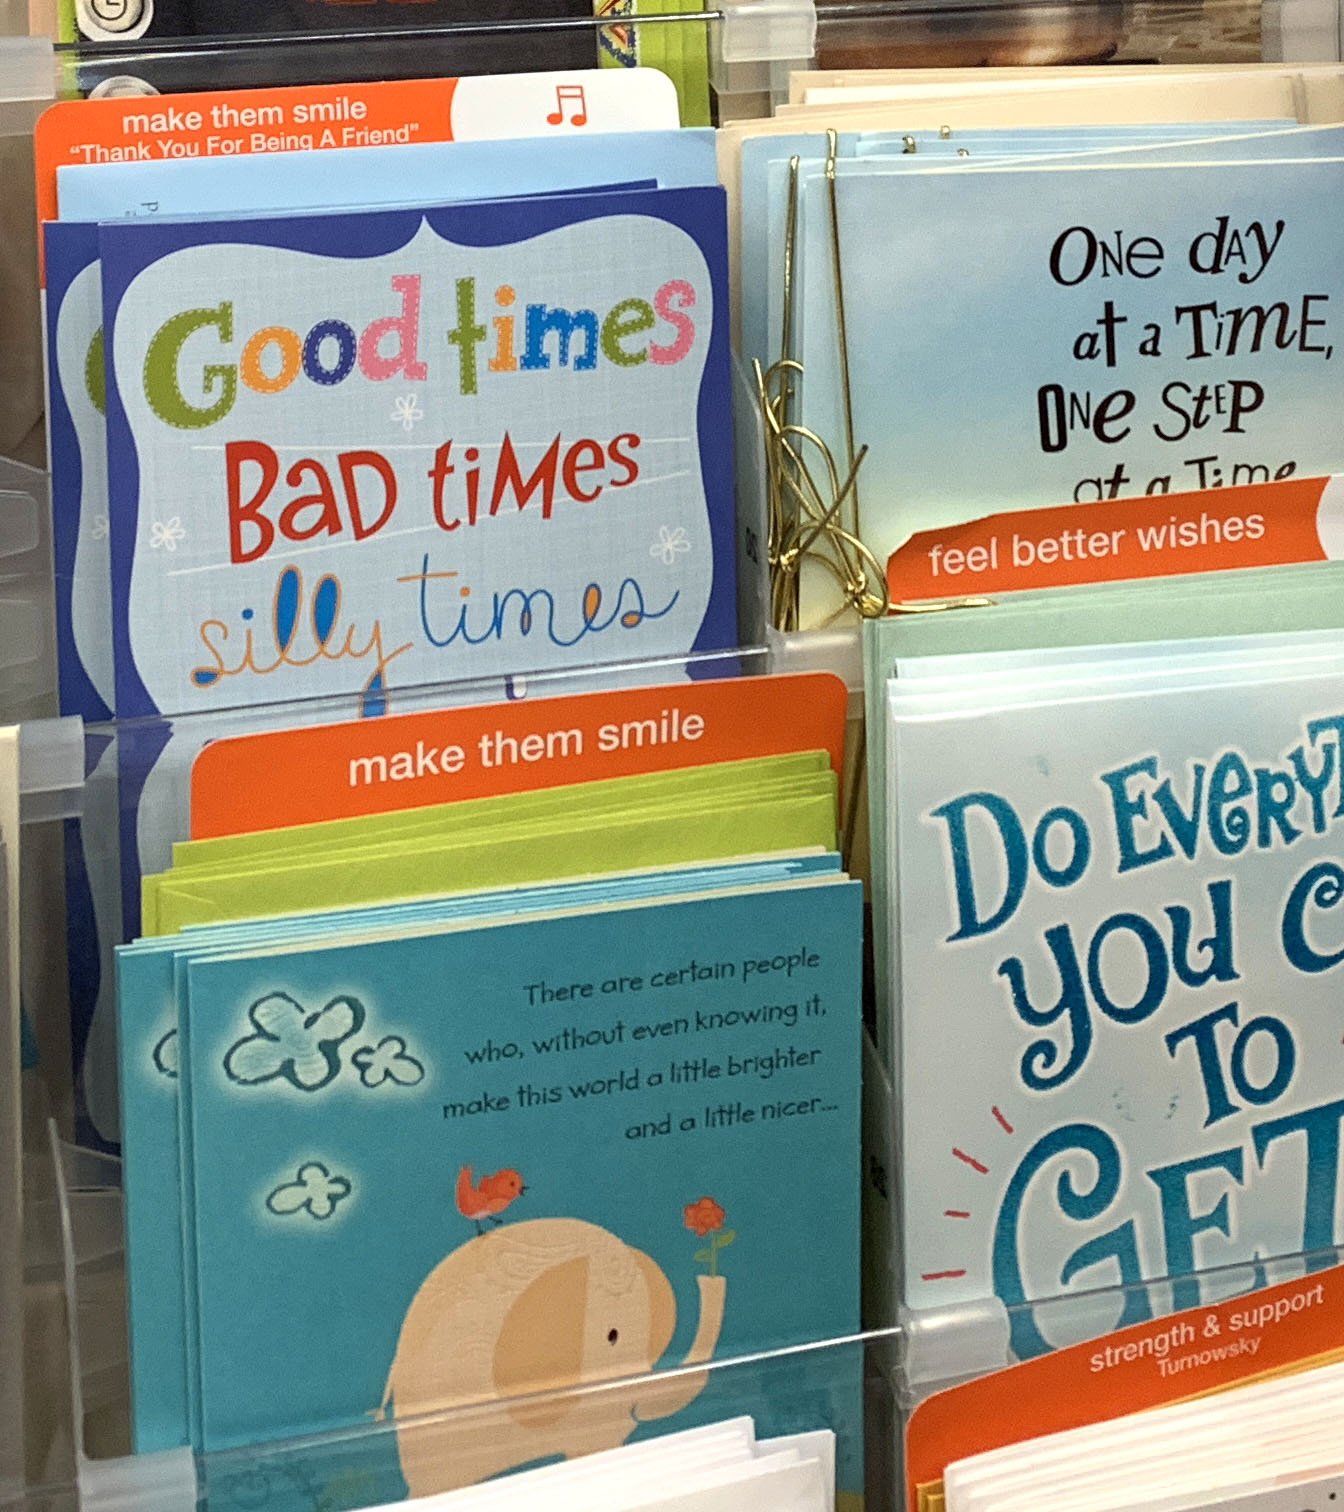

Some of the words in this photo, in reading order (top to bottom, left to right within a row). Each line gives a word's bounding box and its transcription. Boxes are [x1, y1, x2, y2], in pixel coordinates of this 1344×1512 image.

[123, 108, 202, 133] make
[211, 104, 283, 128] them
[293, 97, 366, 123] smile
[156, 137, 200, 159] You
[206, 136, 245, 156] For
[250, 131, 314, 156] Being
[320, 130, 335, 146] A
[143, 274, 427, 429] Good
[448, 277, 695, 395] times
[1073, 301, 1127, 367] at
[1139, 324, 1161, 356] a
[928, 533, 997, 576] feel
[1012, 525, 1124, 568] better
[1137, 513, 1264, 551] wishes
[192, 564, 415, 717] silly
[397, 554, 680, 647] times
[348, 745, 465, 787] make
[479, 730, 582, 767] them
[599, 709, 704, 750] smile
[524, 981, 593, 1005] There
[601, 977, 643, 993] are
[651, 960, 735, 987] certain
[743, 947, 820, 983] people
[464, 1040, 524, 1064] who,
[532, 1021, 624, 1053] without
[632, 1019, 689, 1040] even
[696, 1004, 798, 1040] knowing
[804, 999, 828, 1019] it,
[443, 1092, 510, 1118] make
[517, 1084, 562, 1107] this
[567, 1069, 640, 1102] world
[647, 1073, 662, 1087] a
[671, 1058, 720, 1083] little
[728, 1046, 821, 1079] brighter
[1164, 1002, 1296, 1128] TO
[1089, 1322, 1197, 1372] strength
[1203, 1315, 1220, 1337] &
[1227, 1285, 1324, 1331] support
[1156, 1336, 1262, 1378] Turnowsky
